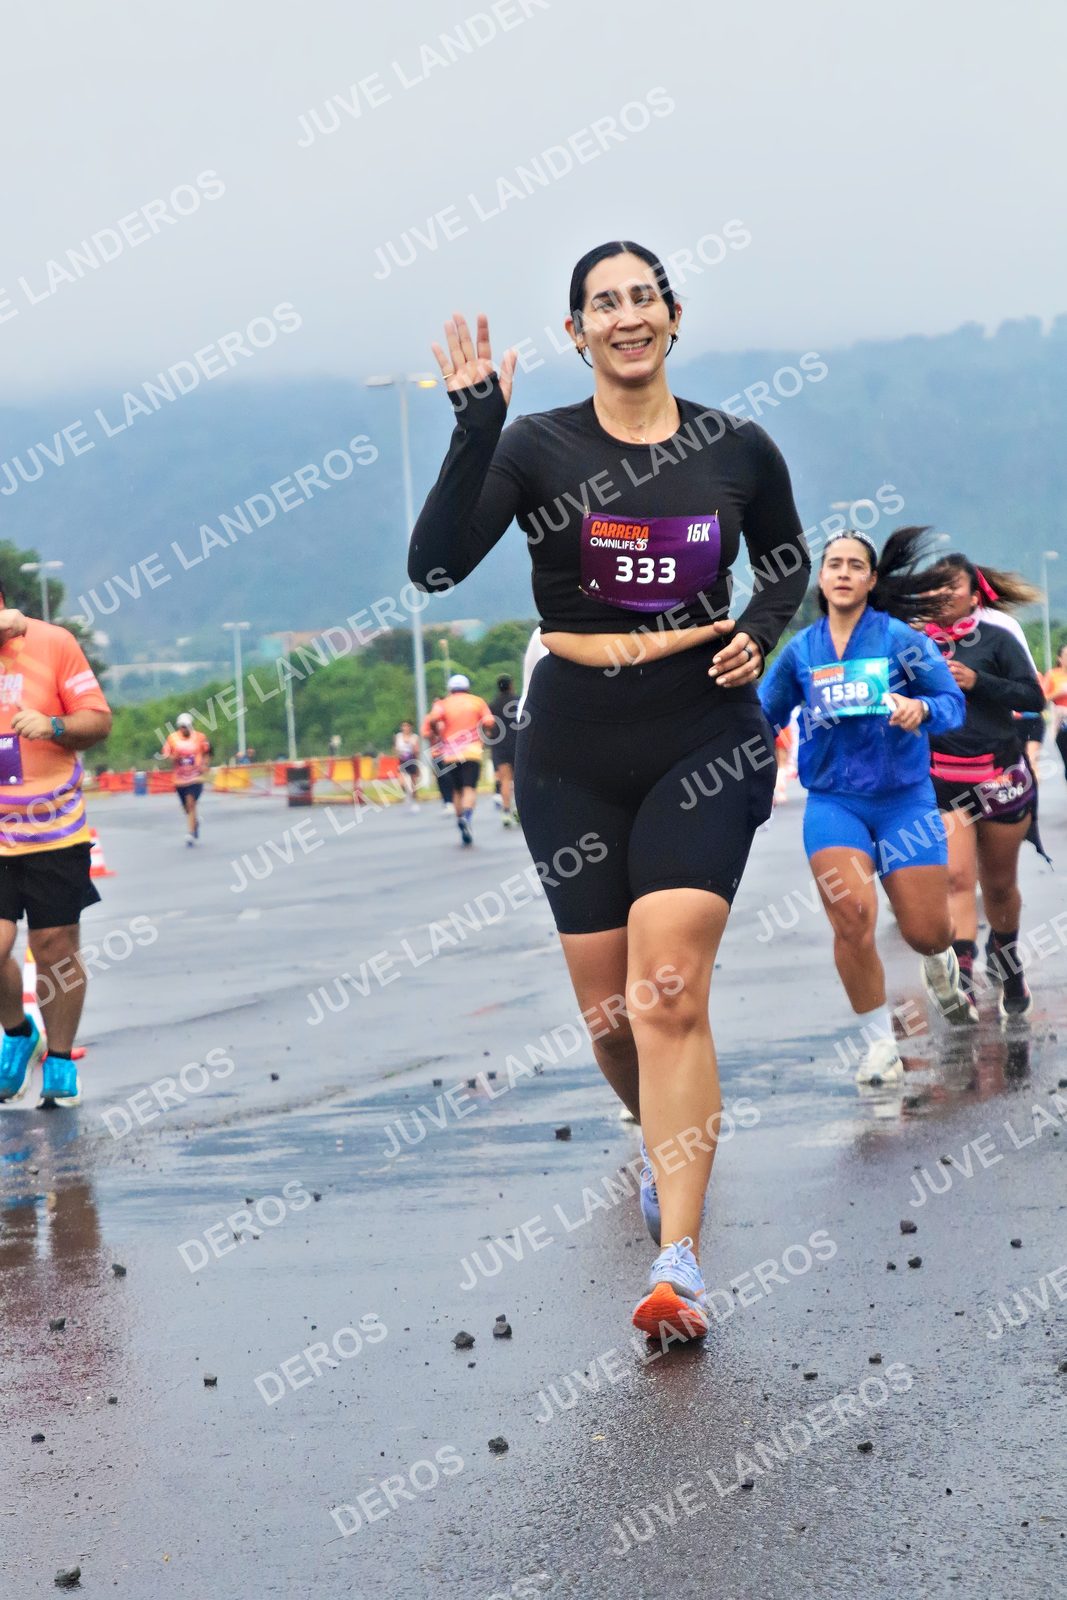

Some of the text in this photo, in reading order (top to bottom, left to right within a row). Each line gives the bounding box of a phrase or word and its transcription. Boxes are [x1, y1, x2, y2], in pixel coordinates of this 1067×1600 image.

[590, 520, 649, 540] CARRERA
[615, 556, 677, 584] 333
[821, 681, 869, 704] 1538
[998, 782, 1024, 804] 506
